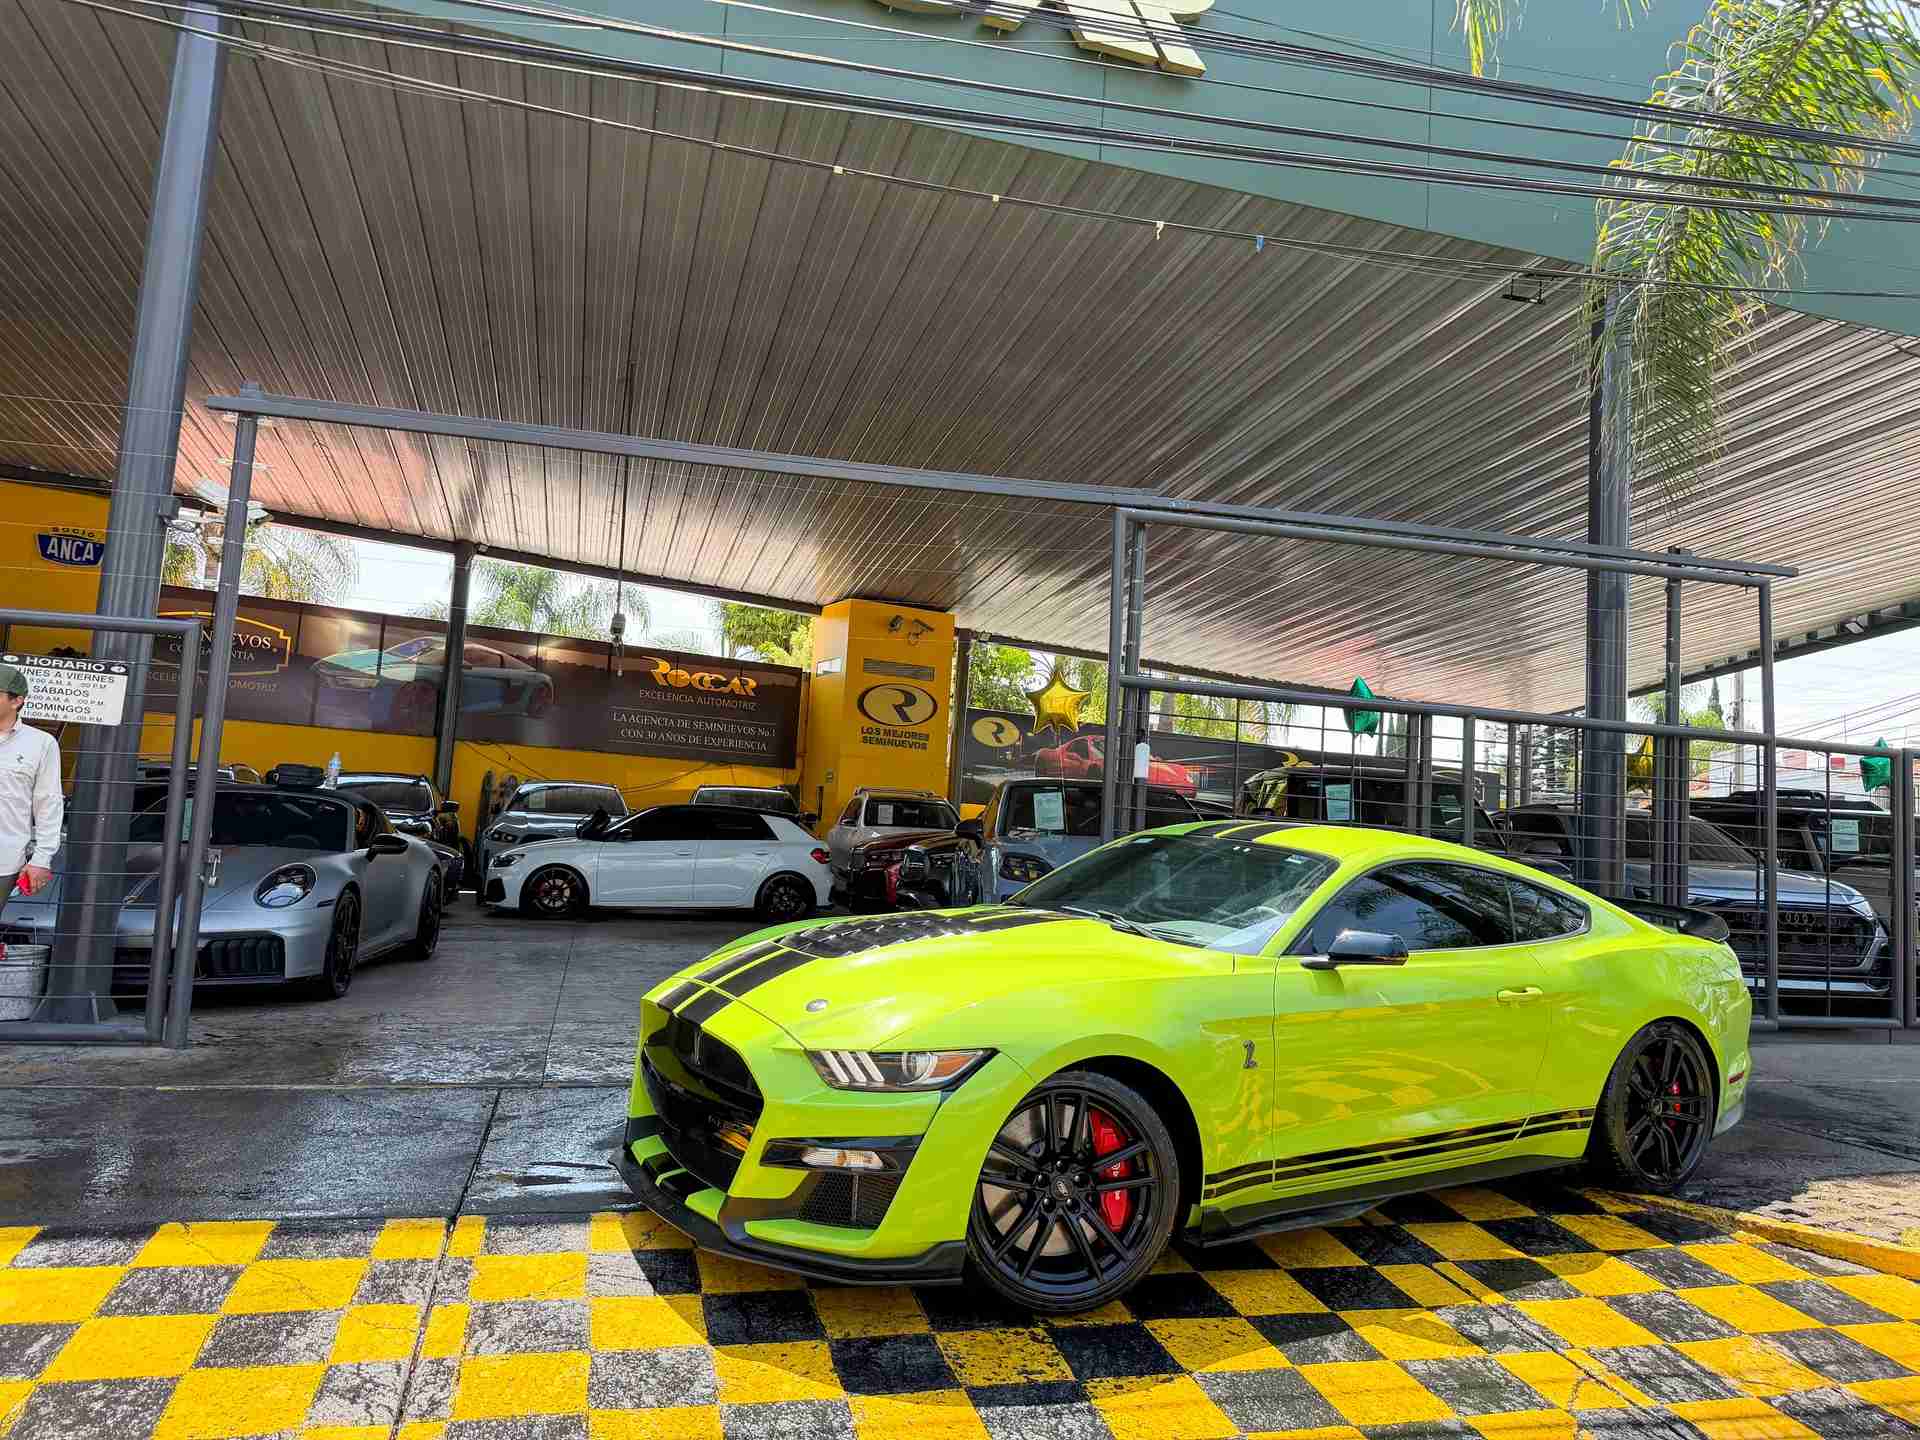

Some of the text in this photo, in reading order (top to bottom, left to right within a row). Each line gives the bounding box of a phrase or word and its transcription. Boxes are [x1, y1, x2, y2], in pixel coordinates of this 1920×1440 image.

[52, 527, 96, 538] SOCIO
[47, 536, 94, 561] ANCA
[26, 656, 105, 671] HORARIO
[66, 672, 114, 683] VIERNES
[26, 702, 91, 714] DOMINGOS
[639, 688, 757, 712] EXCELENCIA AUTOMOTRIZ
[613, 711, 627, 722] LA
[629, 713, 675, 728] AGENCIA
[677, 719, 691, 729] DE
[693, 720, 756, 736] SEMINUEVOS
[620, 727, 645, 739] CON
[660, 729, 686, 744] AÑOS
[688, 733, 702, 745] DE
[704, 735, 768, 752] EXPERIENCIA
[860, 725, 930, 742] LOS MEJORES
[862, 735, 928, 750] SEMINUEVOS
